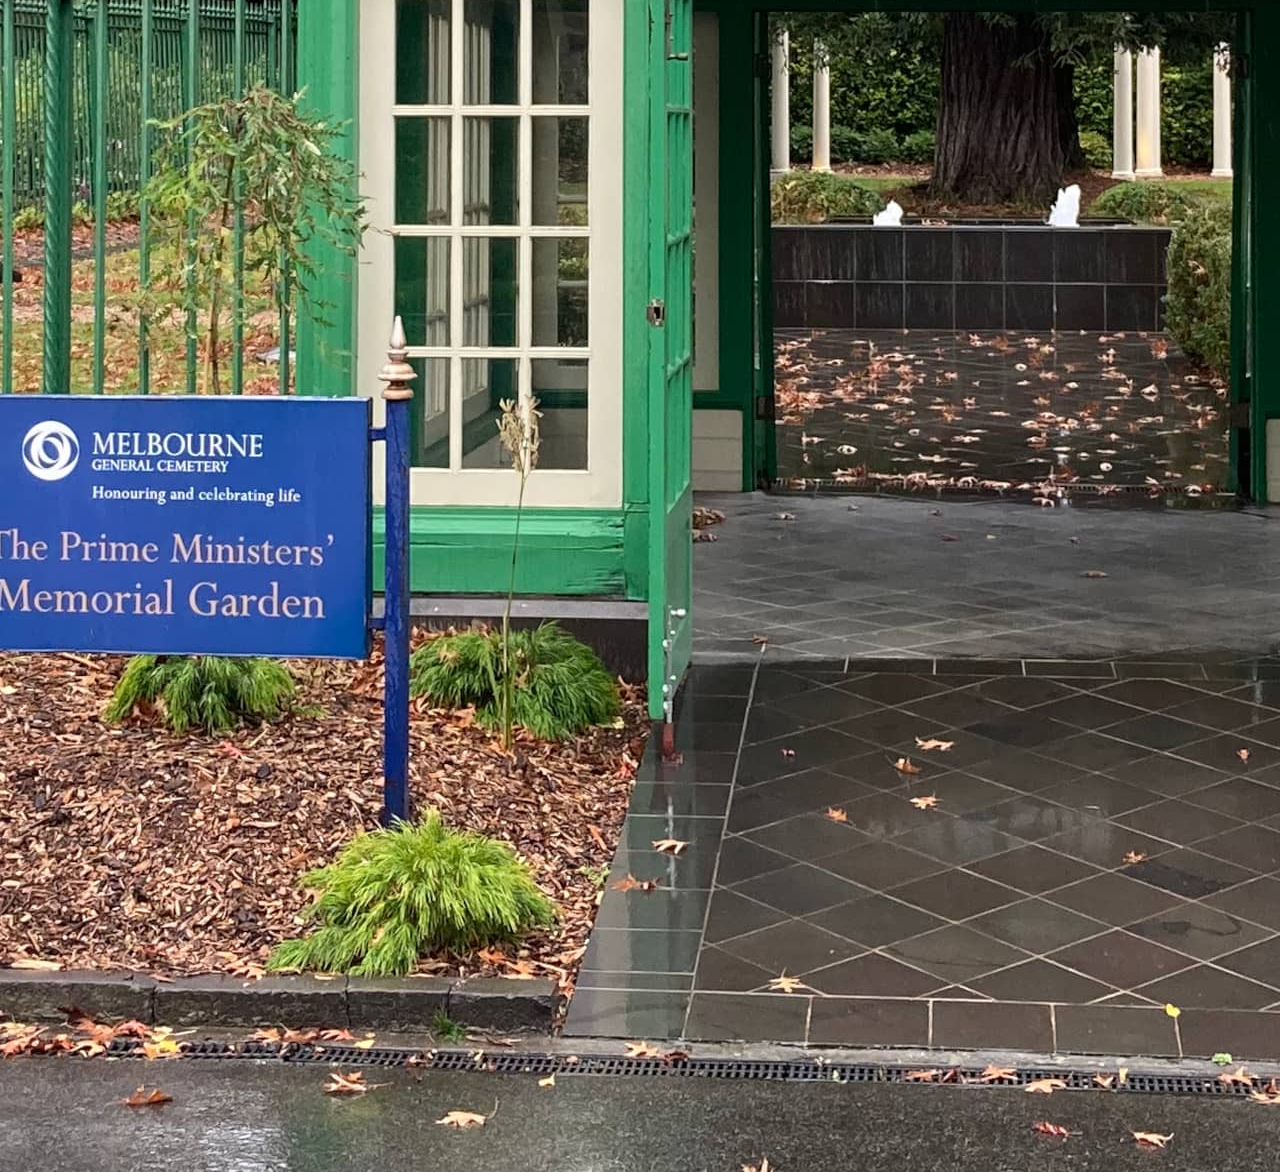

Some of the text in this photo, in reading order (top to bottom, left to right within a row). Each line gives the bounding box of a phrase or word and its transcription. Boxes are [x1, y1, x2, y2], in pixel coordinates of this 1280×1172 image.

[92, 431, 263, 458] MELBOURNE
[91, 458, 229, 473] GENERAL CEMETERY
[92, 485, 301, 508] Honouring and celebrating life
[60, 531, 159, 563] Prime
[188, 581, 325, 618] Garden
